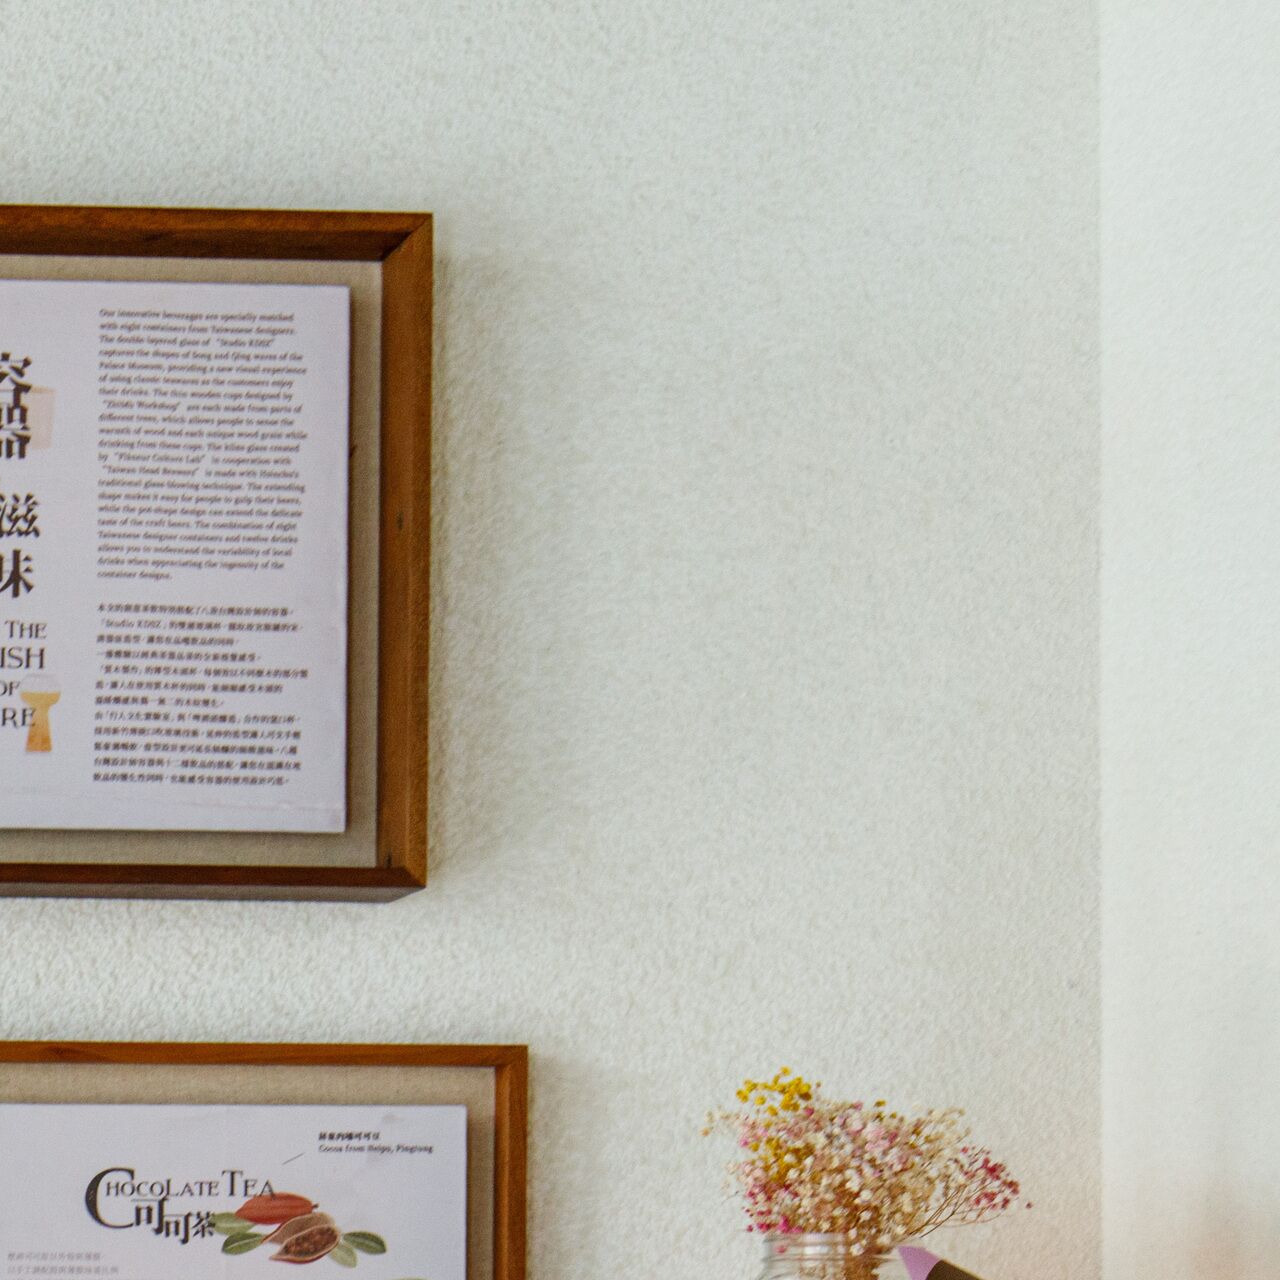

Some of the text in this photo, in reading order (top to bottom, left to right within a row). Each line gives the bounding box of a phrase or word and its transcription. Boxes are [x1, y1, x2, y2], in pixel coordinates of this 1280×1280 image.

[4, 619, 47, 640] THE
[85, 1167, 276, 1229] CHOCOLATE TEA
[133, 1197, 218, 1245] 可可茶
